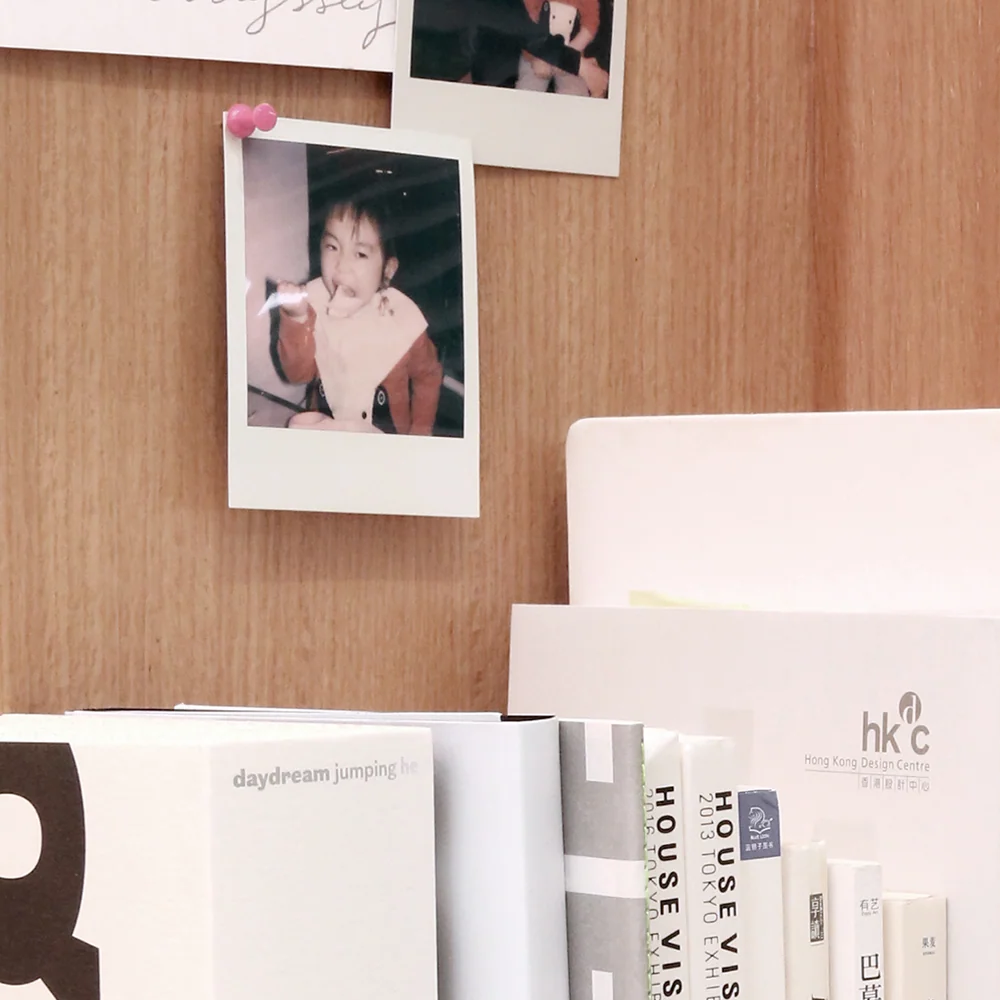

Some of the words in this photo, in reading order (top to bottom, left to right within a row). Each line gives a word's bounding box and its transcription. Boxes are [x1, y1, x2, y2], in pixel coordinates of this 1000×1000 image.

[233, 766, 331, 791] daydream
[332, 760, 398, 785] jumping
[804, 754, 829, 769] Hong
[832, 756, 858, 771] Kong
[861, 757, 895, 772] Design
[896, 759, 930, 772] Centre
[699, 793, 715, 841] 2013
[655, 785, 680, 917] HOUSE
[715, 791, 738, 920] HOUSE
[701, 848, 719, 924] TOKYO
